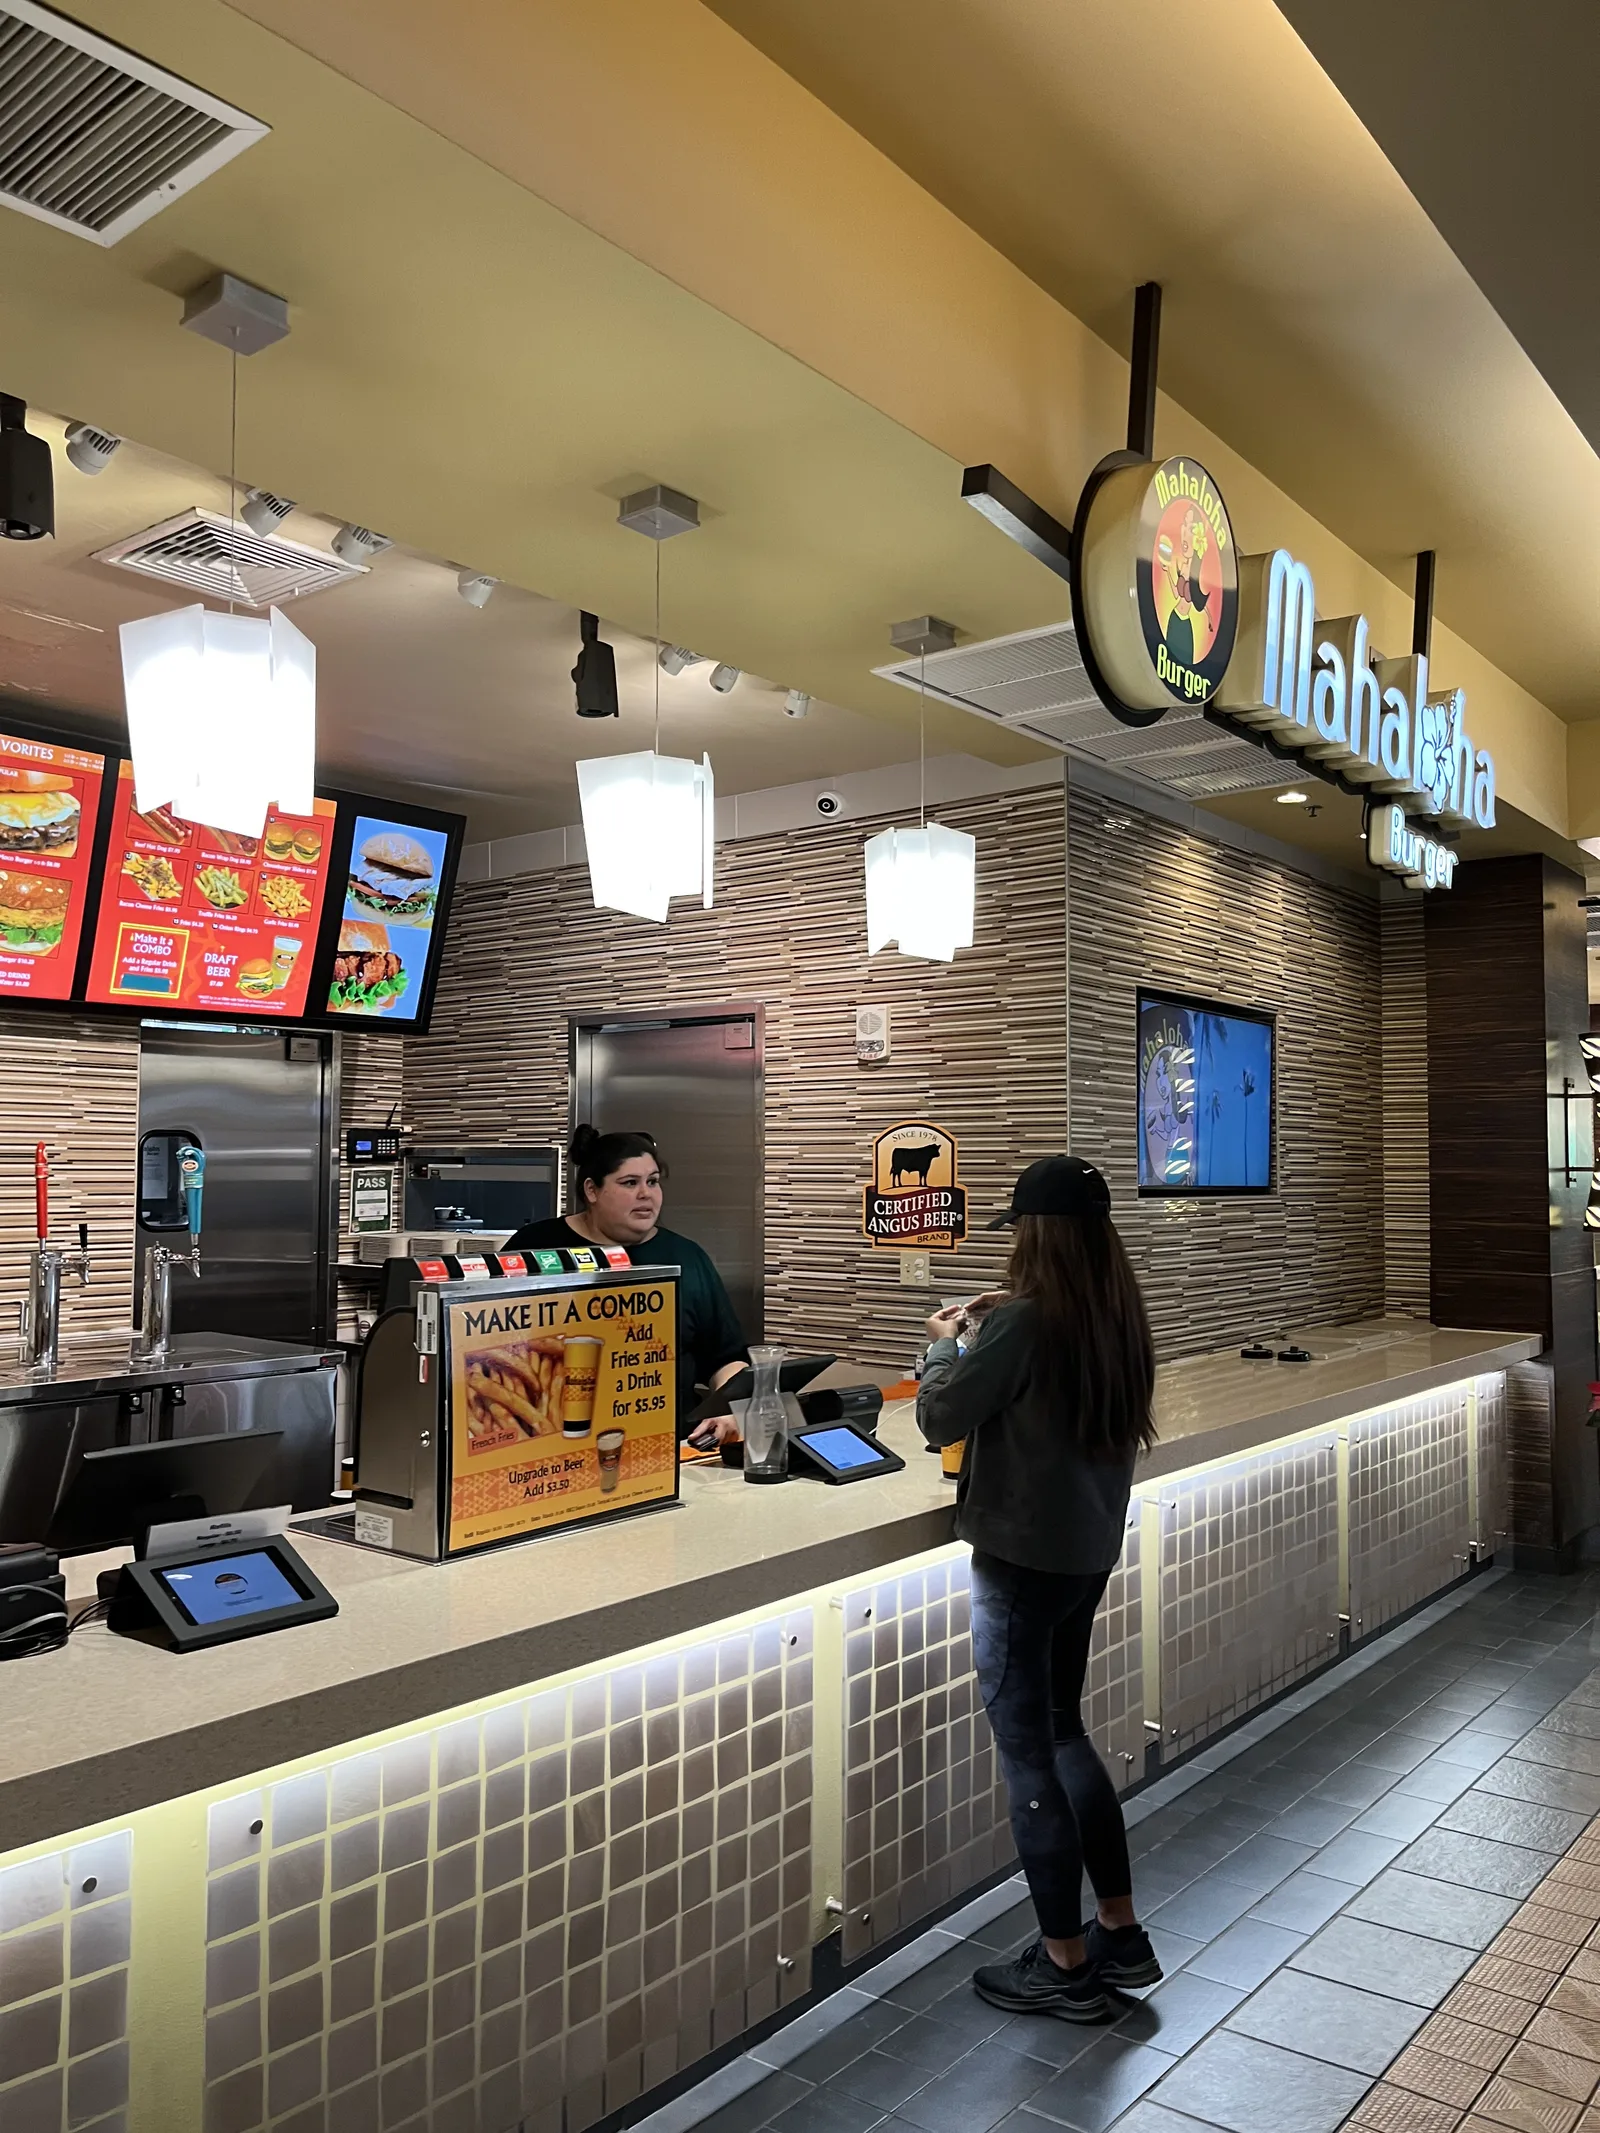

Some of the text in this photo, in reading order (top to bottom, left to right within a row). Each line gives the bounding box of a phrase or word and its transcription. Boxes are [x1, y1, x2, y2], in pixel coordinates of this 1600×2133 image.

[1154, 462, 1227, 550] Mahaloha
[1157, 643, 1211, 699] Burger
[0, 739, 54, 760] VORITES
[1389, 803, 1459, 890] Burger
[134, 932, 158, 944] Make
[159, 935, 167, 945] it
[133, 943, 172, 956] COMBO
[203, 952, 239, 966] DRAFT
[207, 965, 231, 978] BEER
[892, 1130, 938, 1143] SINCE 1978
[357, 1177, 386, 1189] PASS
[873, 1191, 952, 1215] CERTIFIED
[867, 1214, 920, 1233] ANGUS
[917, 1232, 949, 1243] BRAND
[462, 1305, 532, 1336] MAKE
[538, 1301, 559, 1327] IT
[563, 1299, 582, 1324] A
[587, 1290, 664, 1321] COMBO
[624, 1323, 653, 1343] Add
[611, 1344, 667, 1369] Fries and
[616, 1379, 623, 1393] a
[627, 1369, 662, 1391] Drink
[612, 1395, 666, 1418] for $5.95
[471, 1431, 515, 1451] French Fries
[508, 1465, 549, 1485] Upgrade
[551, 1464, 562, 1475] to
[564, 1458, 585, 1471] Beer
[523, 1478, 570, 1499] Add $3.50
